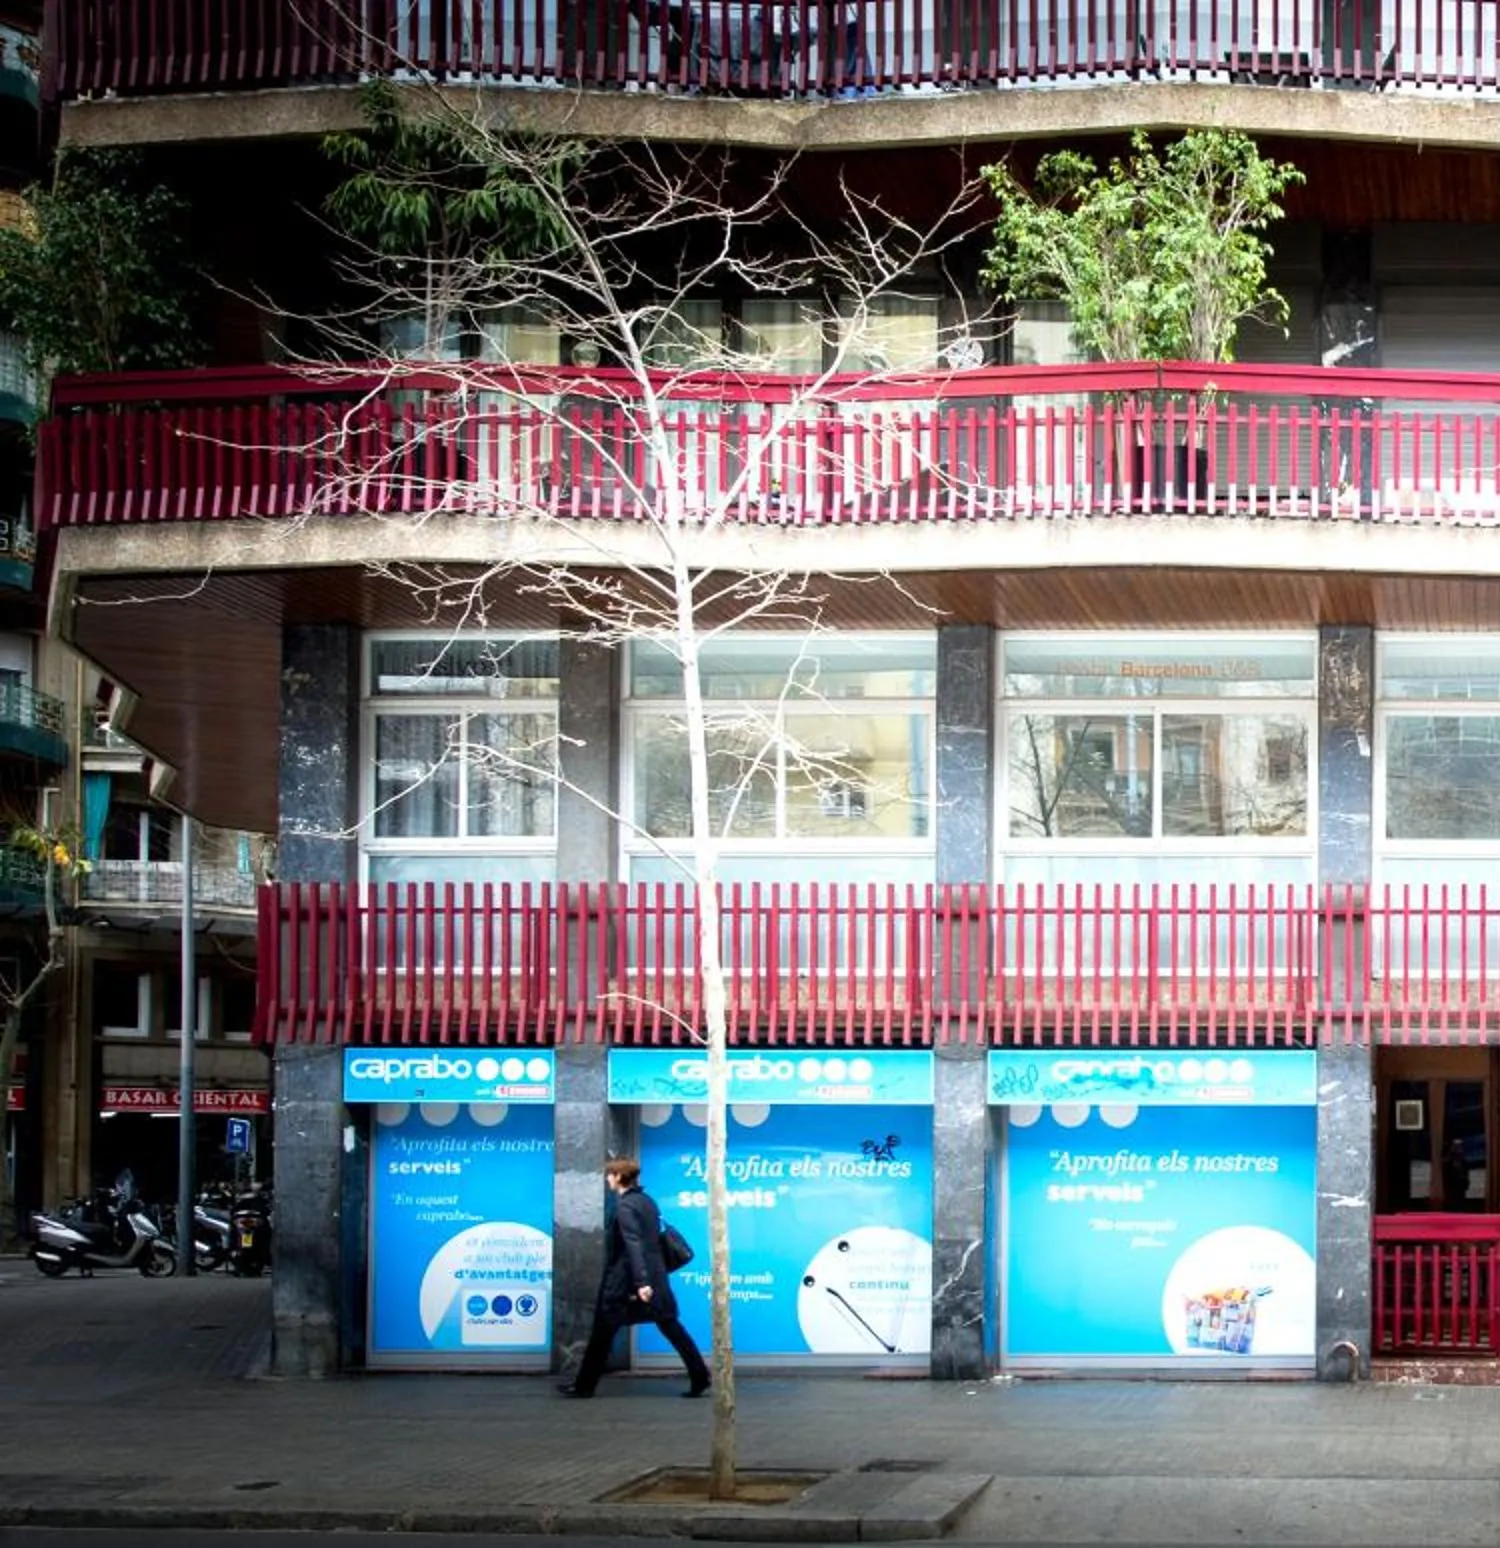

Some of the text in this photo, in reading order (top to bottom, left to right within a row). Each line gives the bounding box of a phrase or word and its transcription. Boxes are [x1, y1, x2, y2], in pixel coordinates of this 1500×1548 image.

[1119, 660, 1214, 679] Barcelona
[350, 1053, 473, 1085] caprabo
[672, 1054, 795, 1081] carabo
[106, 1091, 167, 1105] BASAR
[233, 1124, 243, 1137] P
[471, 1135, 497, 1151] els
[788, 1153, 822, 1178] els
[828, 1157, 913, 1179] nostres
[1156, 1149, 1189, 1174] els
[1194, 1153, 1280, 1174] nostres
[678, 1183, 790, 1210] seveis”
[849, 1279, 911, 1291] continu
